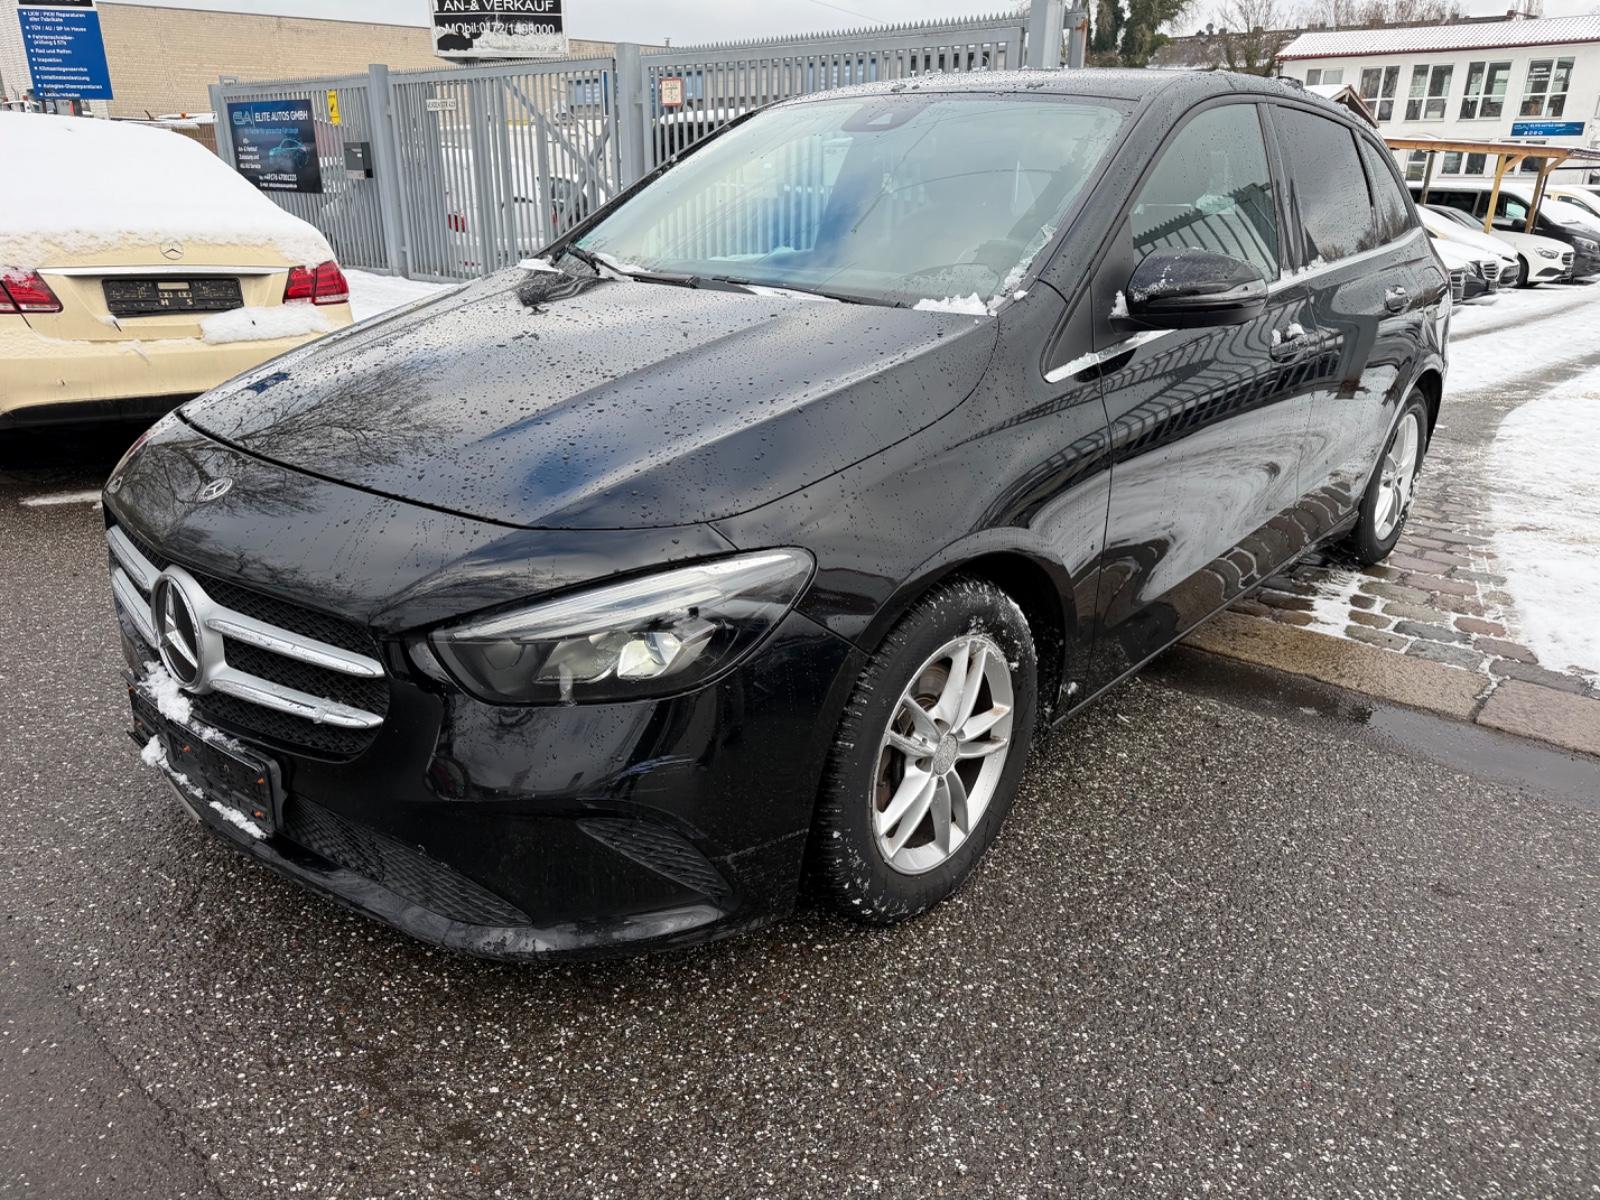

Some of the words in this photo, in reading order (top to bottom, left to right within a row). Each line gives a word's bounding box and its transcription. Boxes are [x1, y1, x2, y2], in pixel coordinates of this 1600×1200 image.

[482, 0, 554, 12] VERKAUF
[255, 112, 271, 122] ELITE
[271, 111, 290, 121] AUTOS
[290, 110, 308, 121] GMBH
